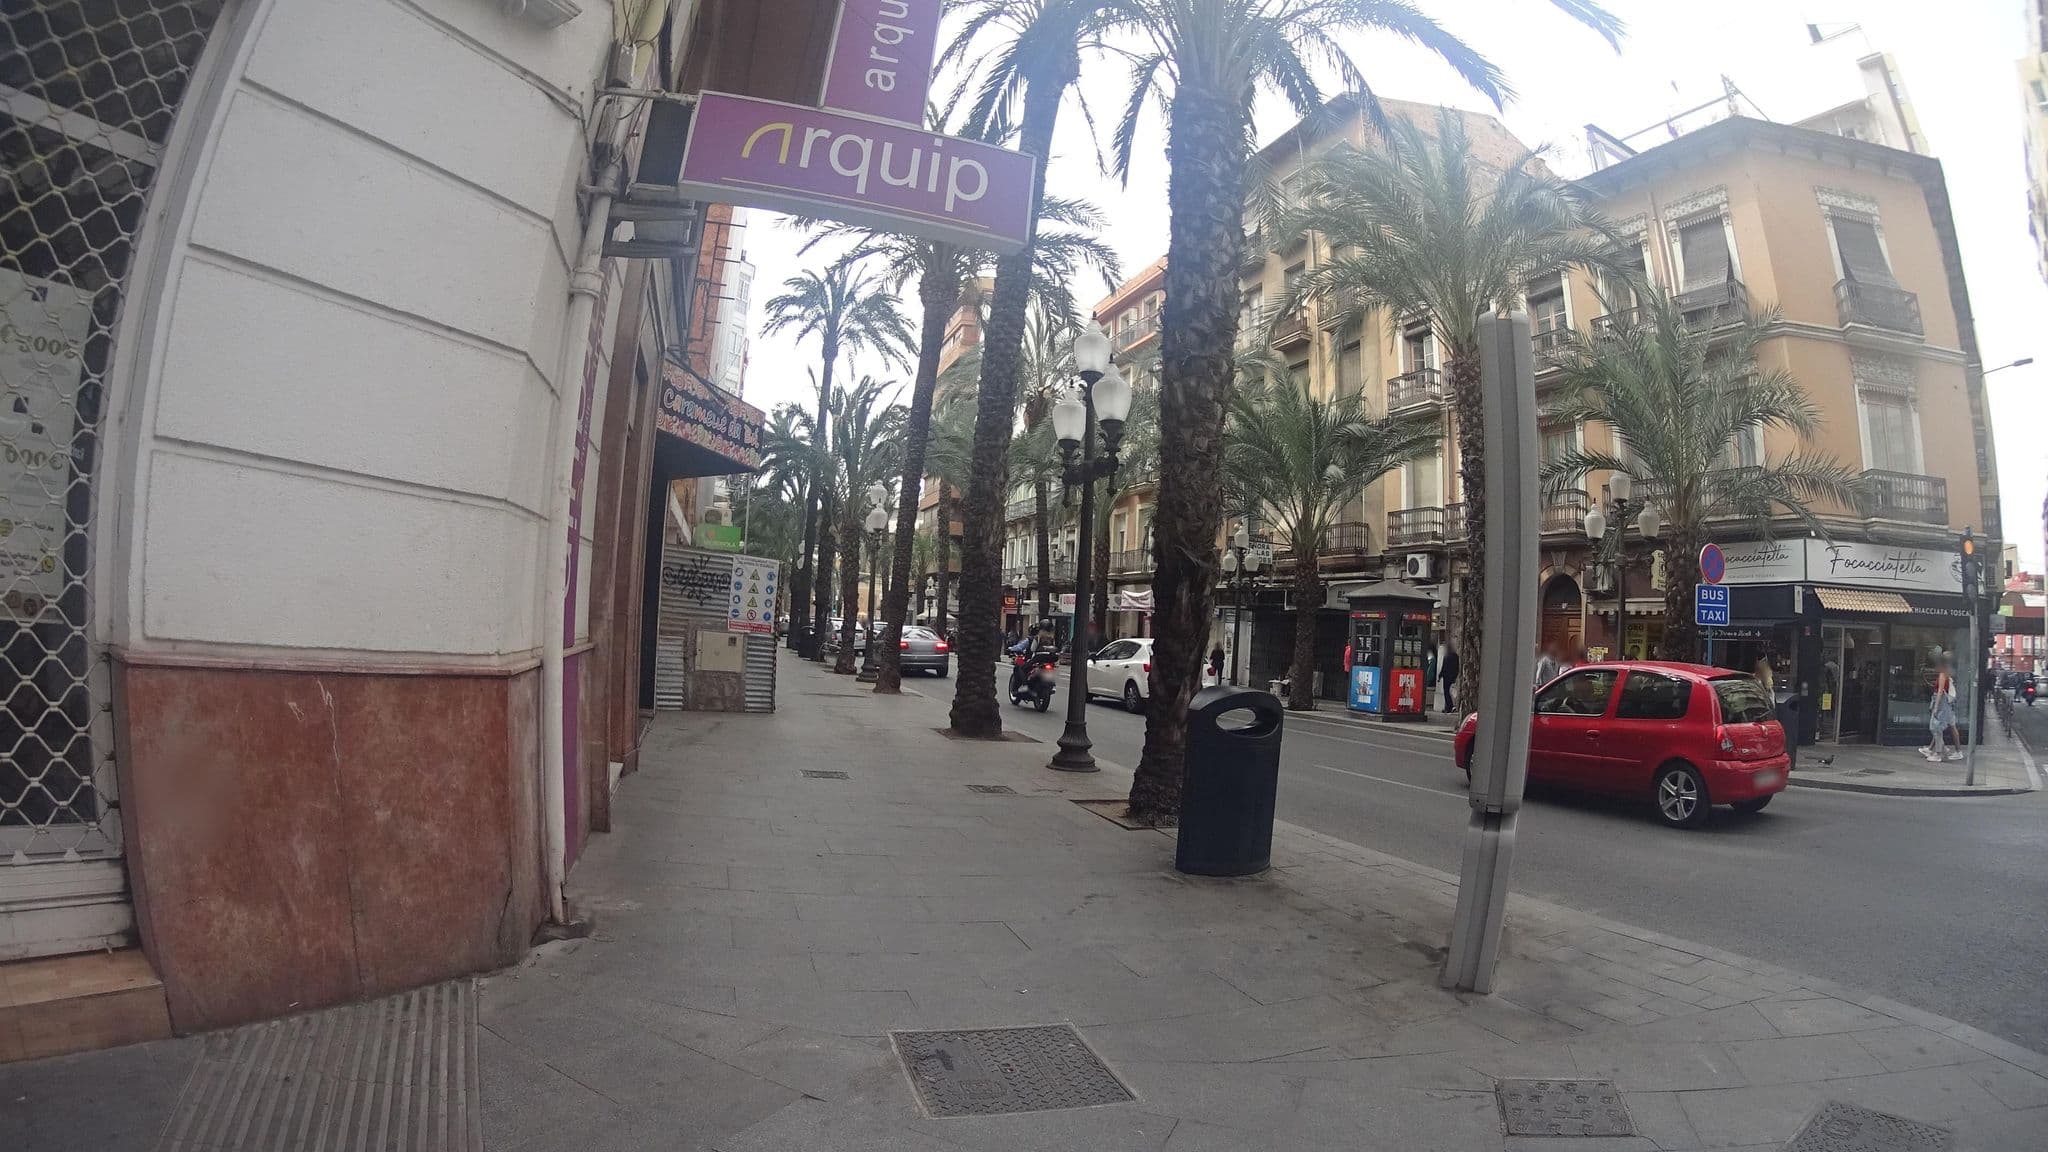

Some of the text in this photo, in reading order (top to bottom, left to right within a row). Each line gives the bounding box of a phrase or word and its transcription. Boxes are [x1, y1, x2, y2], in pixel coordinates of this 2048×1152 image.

[1720, 544, 1792, 568] ocacciatella
[1826, 545, 1929, 580] Focacciatella
[1701, 589, 1724, 601] BUS
[1701, 610, 1725, 621] TAXI
